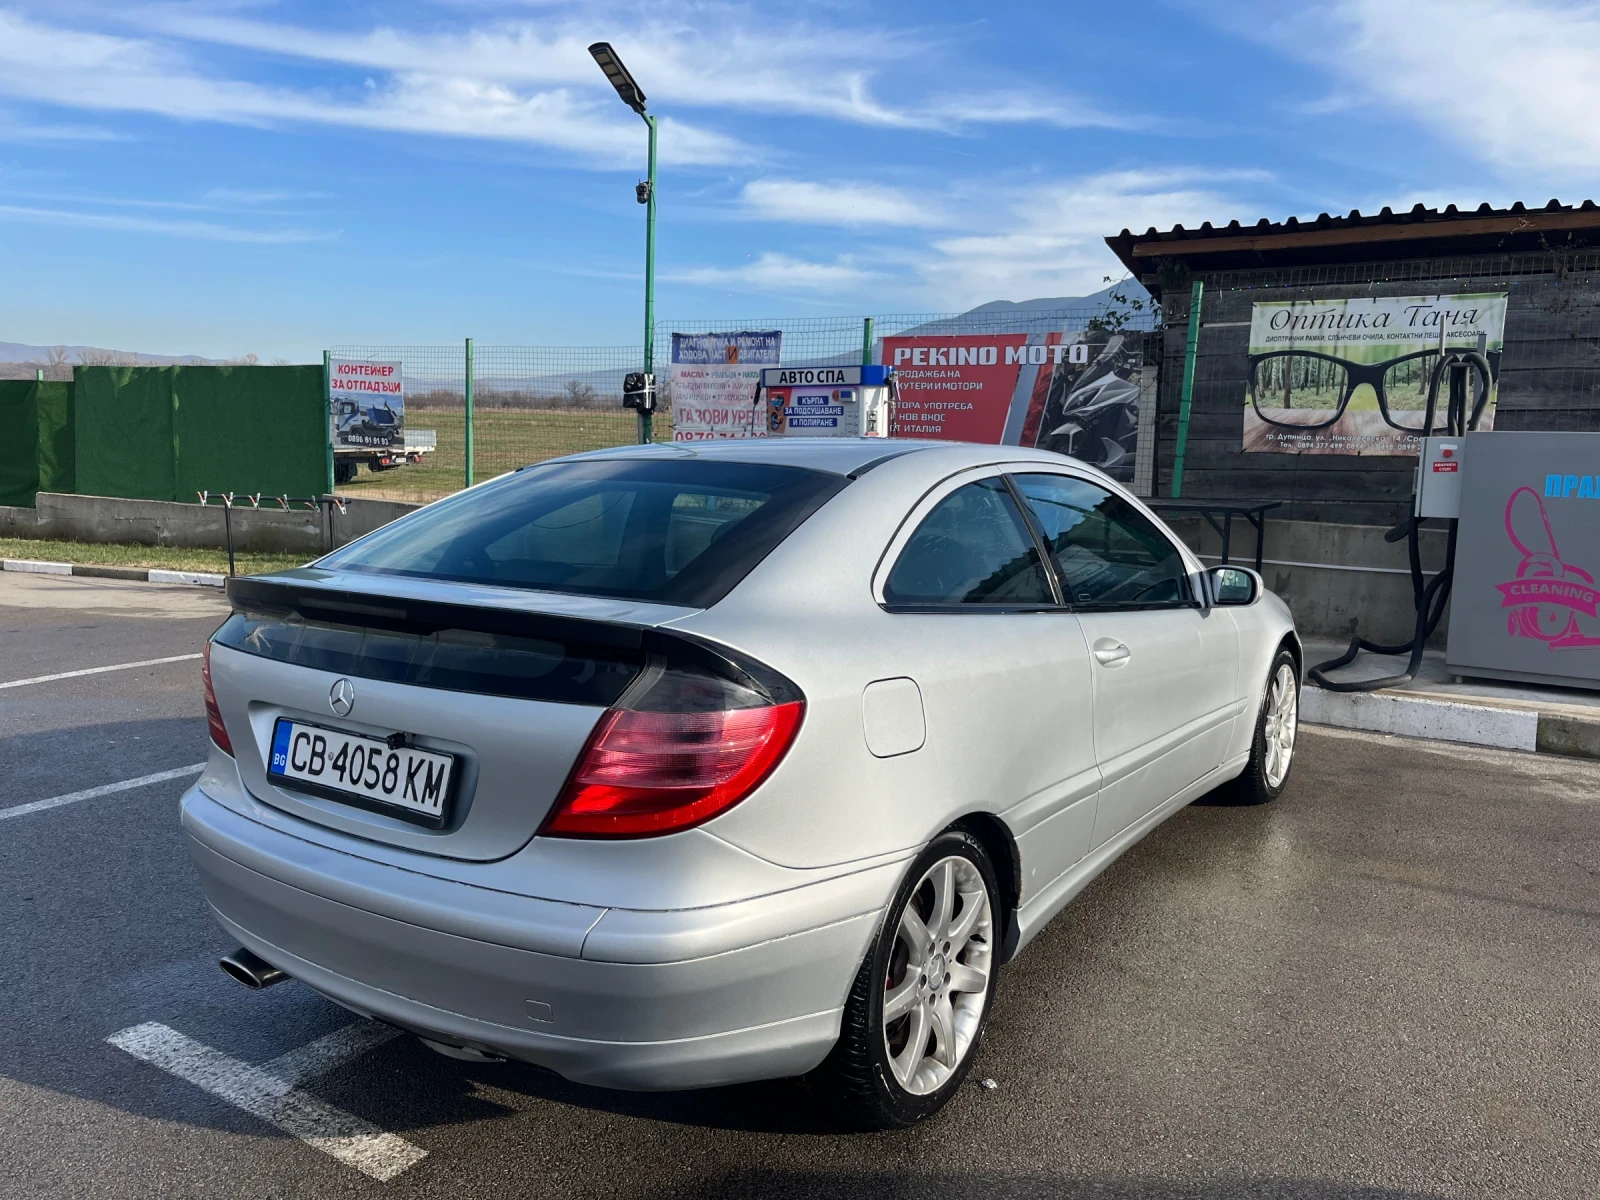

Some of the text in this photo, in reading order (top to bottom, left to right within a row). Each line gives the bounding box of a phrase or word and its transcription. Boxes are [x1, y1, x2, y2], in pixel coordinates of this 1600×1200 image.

[1270, 305, 1484, 331] Оптика Таня
[679, 338, 729, 347] ДИАГНОТИКА
[765, 337, 775, 346] НА
[1265, 335, 1304, 343] ДИОПТРИЧНИ
[679, 350, 707, 360] ХОДОВА
[894, 344, 1089, 366] PEKINO MOTO
[338, 364, 394, 377] КОНТЕЙНЕР
[947, 370, 961, 378] НА
[779, 370, 845, 384] АВТО СПА
[332, 379, 401, 394] ЗА ОТПАДЪЦИ
[896, 382, 983, 391] КУТЕРИ И МОТОРИ
[801, 397, 824, 405] КЪРПА
[923, 402, 973, 410] УПОТРЕБА
[679, 408, 728, 424] ГАЗОВИ
[784, 407, 842, 416] ЗА ПОДСУШАВАНЕ
[899, 413, 918, 421] НОВ
[921, 413, 946, 422] ВНОС
[904, 425, 942, 433] ИТАЛИЯ
[1510, 582, 1595, 603] CLEANING
[273, 753, 286, 767] BG
